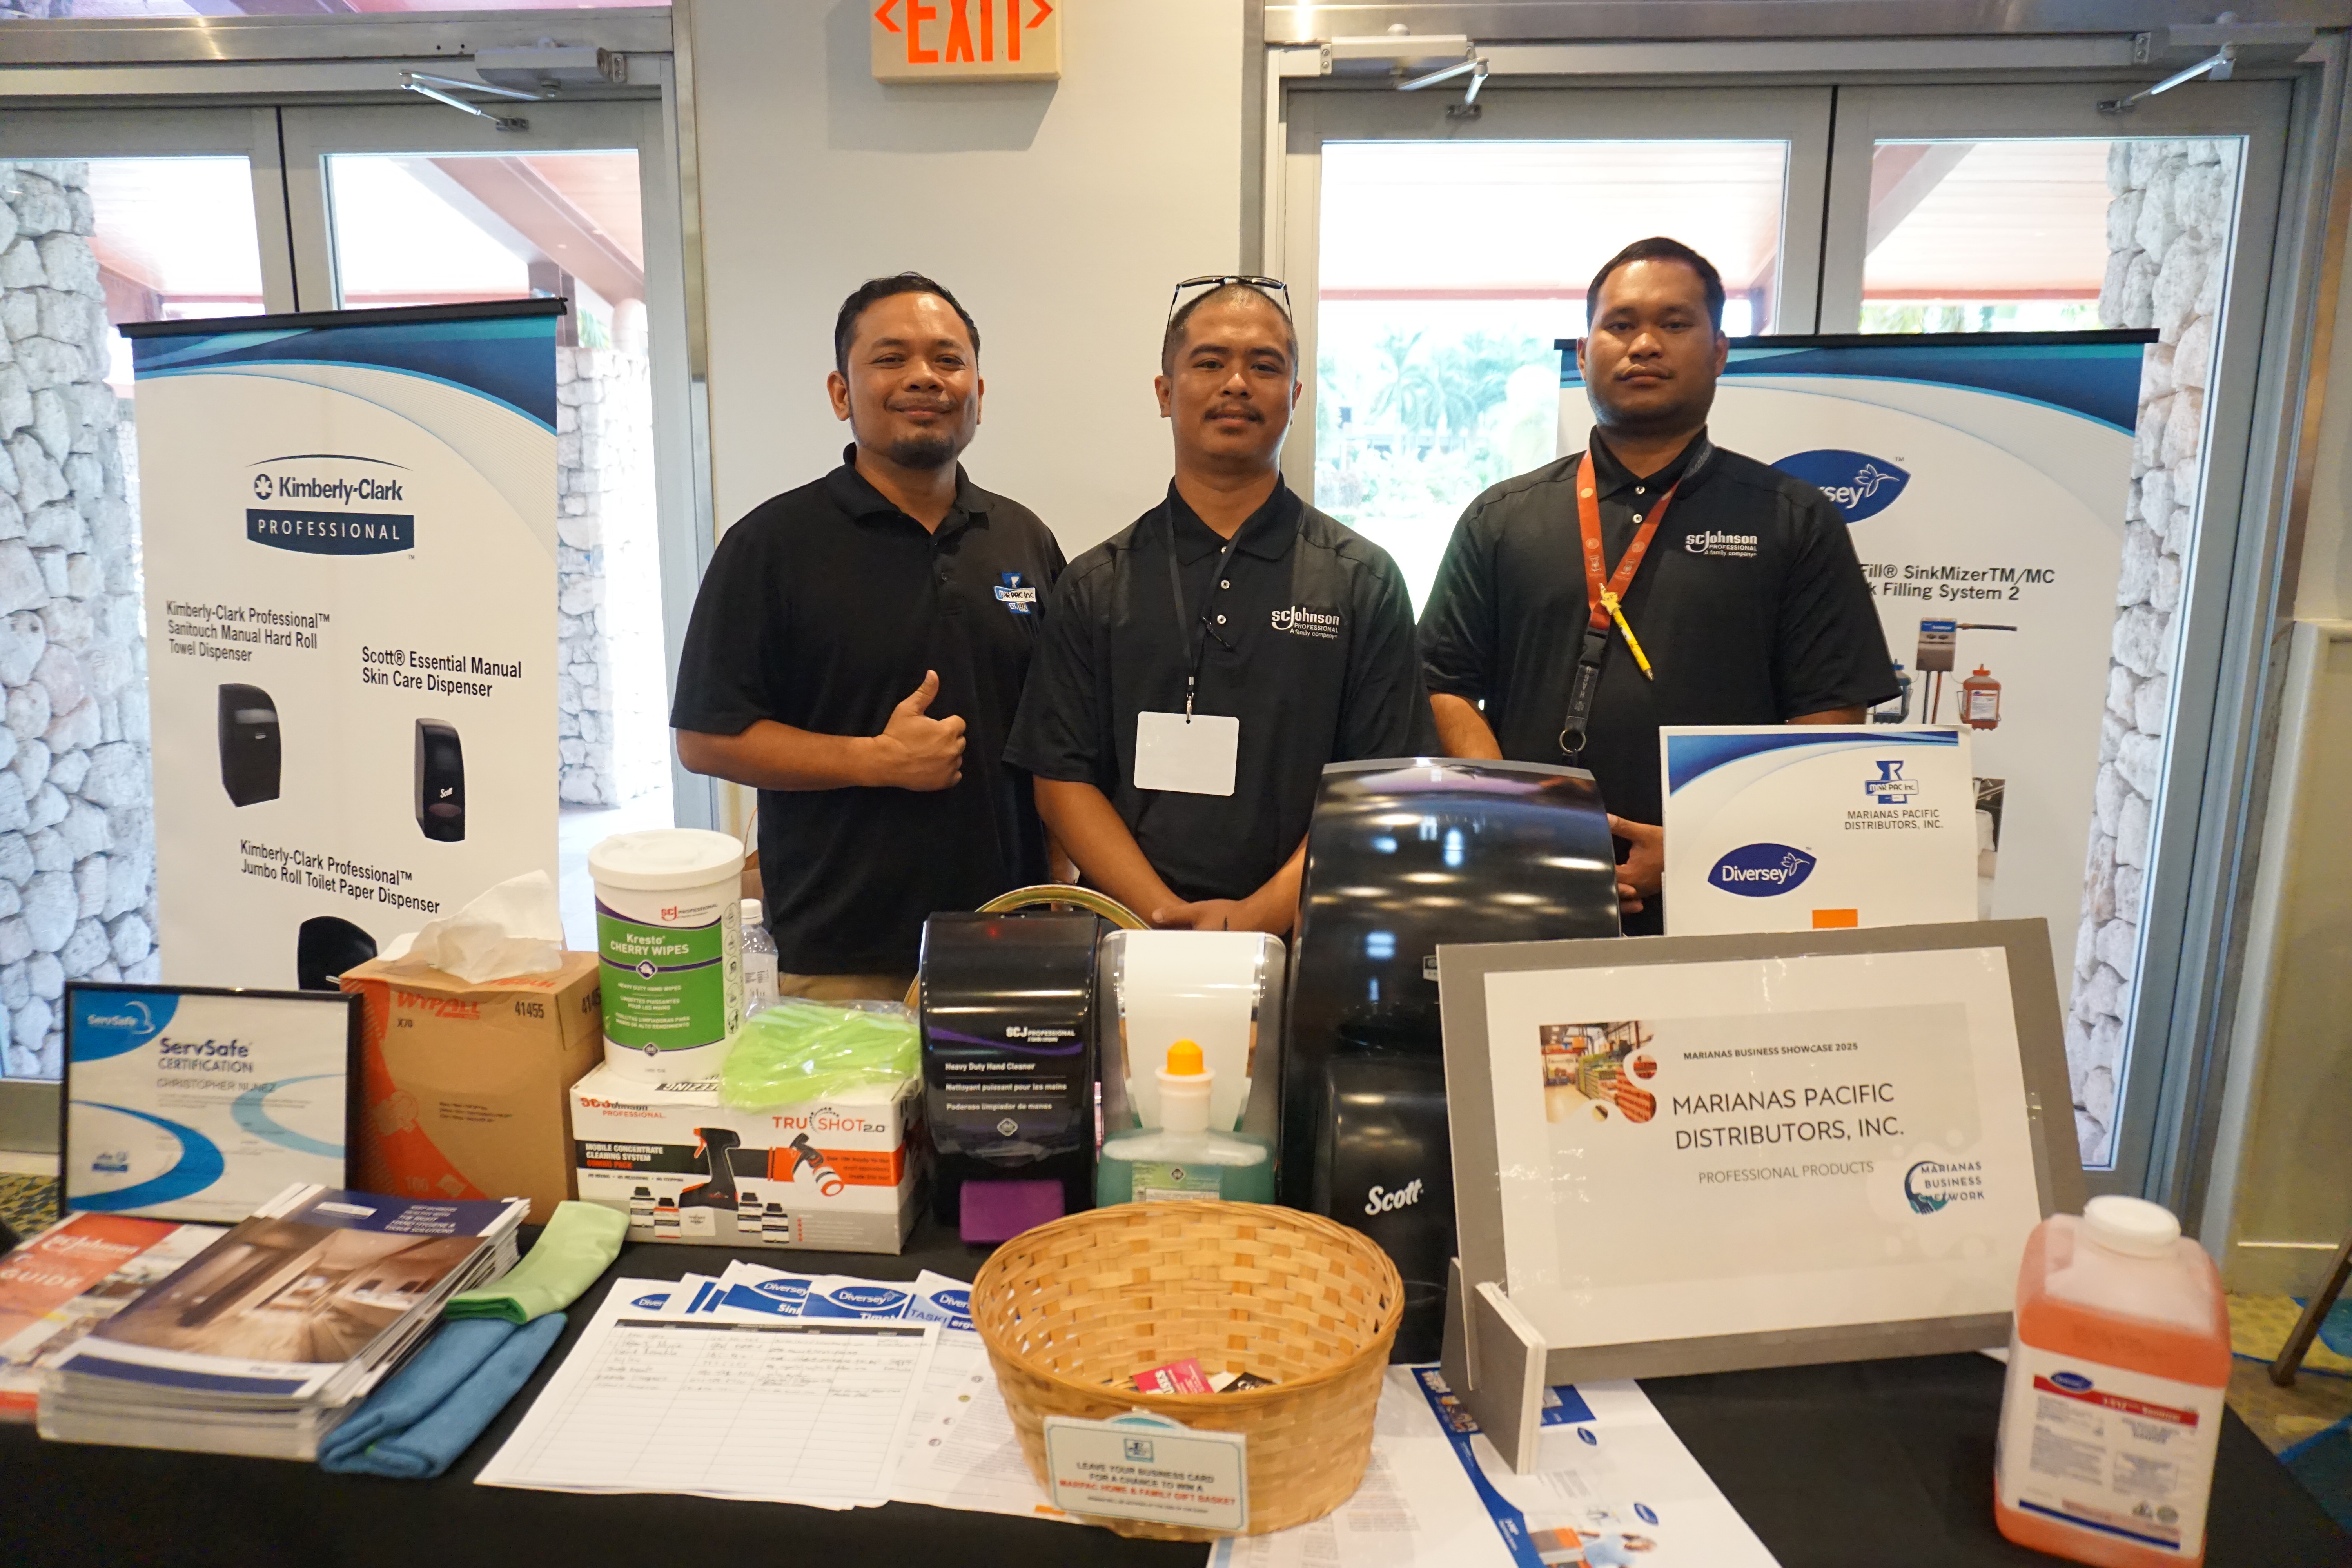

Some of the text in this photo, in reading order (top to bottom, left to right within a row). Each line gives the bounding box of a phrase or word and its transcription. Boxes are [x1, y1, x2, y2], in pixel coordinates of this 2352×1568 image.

[906, 0, 1020, 64] EXIT
[279, 477, 403, 506] Kimberly-Clark
[258, 519, 400, 541] PROFESSIONAL
[1904, 564, 2056, 586] SinkMizerTM/MC
[1883, 582, 1933, 600] Filling
[1939, 583, 2002, 601] System
[2009, 586, 2020, 600] 2
[166, 600, 245, 622] Kimberly-Clark
[168, 619, 318, 649] Sanitouch Manual Hard Roll
[1294, 622, 1339, 633] PROFESSIONAL
[1295, 629, 1310, 637] family
[169, 638, 253, 662] Towel Dispenser
[410, 651, 466, 673] Essential
[471, 657, 522, 678] Manual
[363, 667, 493, 697] Skin Care Dispenser
[440, 787, 454, 798] Scott
[1847, 809, 1940, 819] MARIANAS PACIFIC
[1844, 820, 1944, 830] DISTRIBUTORS, INC.
[240, 839, 324, 870] Kimberly-Clark
[1722, 865, 1789, 885] Diversey
[241, 858, 440, 914] Jumbo Roll Toilet Paper Dispenser
[678, 903, 718, 914] PROFESSIONAL
[610, 940, 690, 956] CHERRY WIPES
[514, 1001, 545, 1019] 41455
[1683, 1042, 1858, 1060] MARIANAS BUSINESS SHOWCASE 2025
[158, 1058, 254, 1073] CERTIFICATION
[945, 1062, 1036, 1072] Heavy Duty Hand Cleaner
[982, 1083, 1013, 1092] puissant
[1673, 1083, 1895, 1116] MARIANAS PACIFIC
[772, 1116, 808, 1130] TRU
[818, 1117, 866, 1131] SHOT
[1676, 1116, 1904, 1150] DISTRIBUTORS, INC.
[585, 1143, 664, 1154] MOBILE CONCENTRATE
[586, 1151, 652, 1162] CLEANING SYSTEM
[1699, 1161, 1875, 1184] PROFESSIONAL PRODUCTS
[1921, 1161, 1982, 1174] MARIANAS
[1924, 1176, 1982, 1189] BUSINESS
[1364, 1178, 1423, 1215] Scott
[763, 1282, 810, 1296] Diversey
[839, 1291, 886, 1304] Diversey
[639, 1299, 665, 1307] Diver
[939, 1294, 970, 1308] Diver
[910, 1308, 948, 1324] TASKI
[1076, 1462, 1215, 1483] LEAVE YOUR BUSINESS CARD
